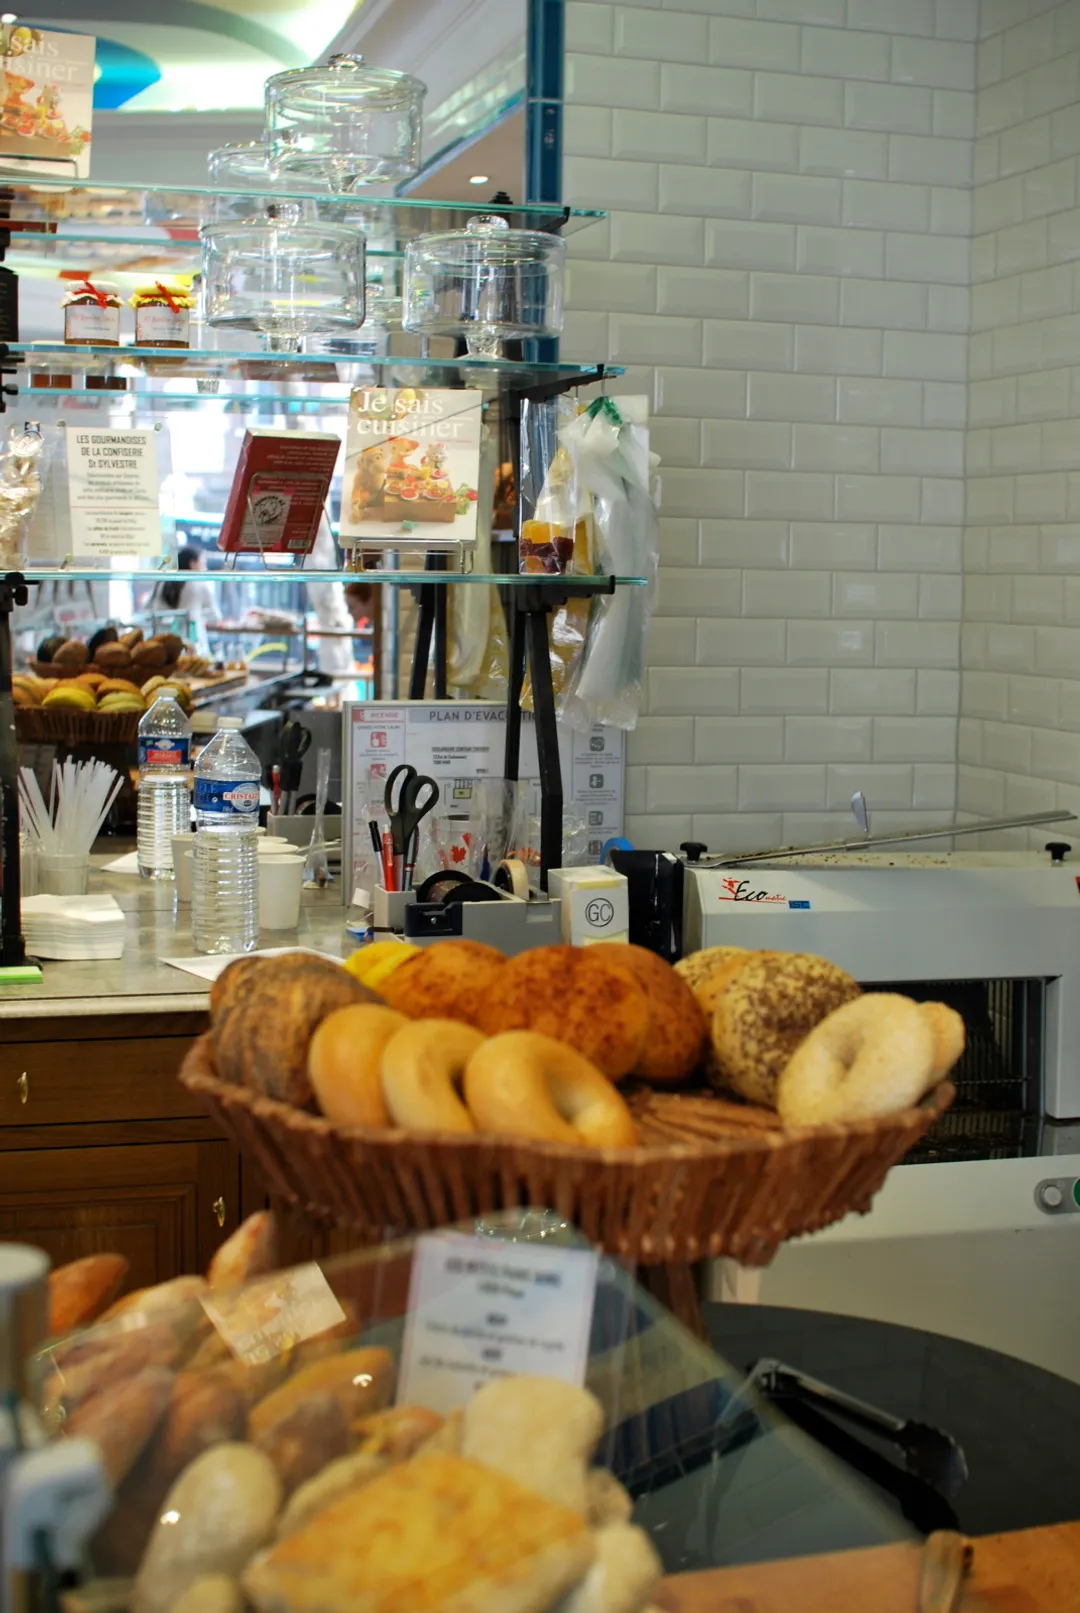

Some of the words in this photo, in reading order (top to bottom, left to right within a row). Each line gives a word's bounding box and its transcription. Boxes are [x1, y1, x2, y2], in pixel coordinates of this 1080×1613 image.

[0, 51, 78, 81] isiner
[358, 391, 387, 413] Je
[395, 393, 443, 414] sais
[356, 415, 464, 437] cuisiner
[76, 435, 89, 444] LES
[91, 435, 146, 445] GOURMANDISES
[81, 447, 90, 456] DE
[92, 448, 101, 456] LA
[102, 448, 143, 457] CONFISERIE
[98, 460, 137, 469] SYLVESTRE
[429, 710, 459, 720] PLAN
[587, 903, 611, 922] GC
